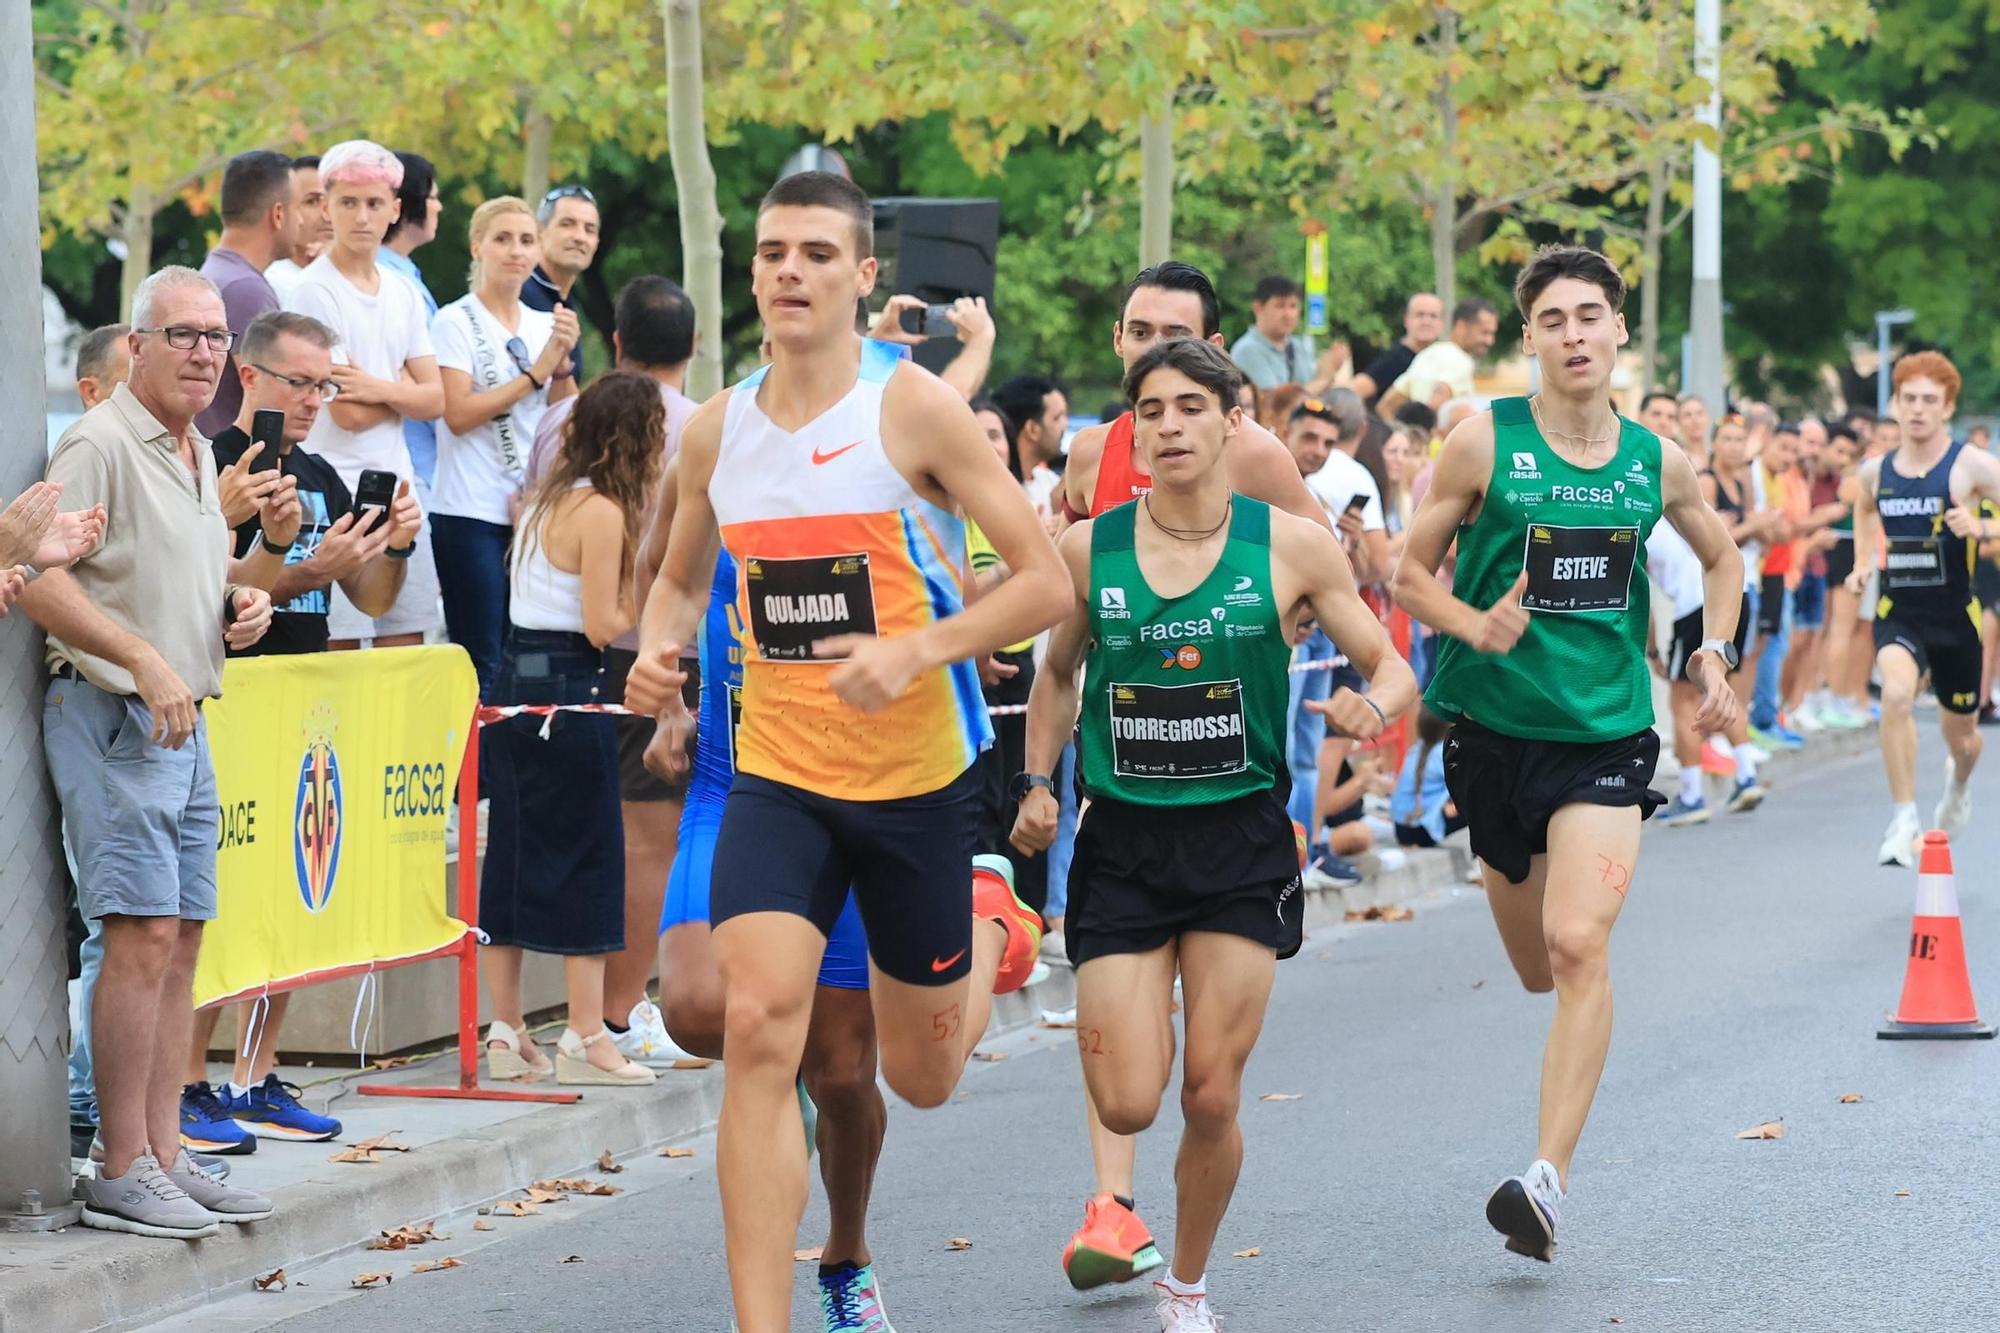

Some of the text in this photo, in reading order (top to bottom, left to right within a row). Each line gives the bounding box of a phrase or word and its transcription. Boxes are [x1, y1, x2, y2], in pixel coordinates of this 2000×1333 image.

[1552, 556, 1609, 580] ESTEVE
[764, 592, 850, 625] QUIJADA
[1180, 650, 1198, 662] Fer
[1113, 713, 1242, 742] TORREGROSSA
